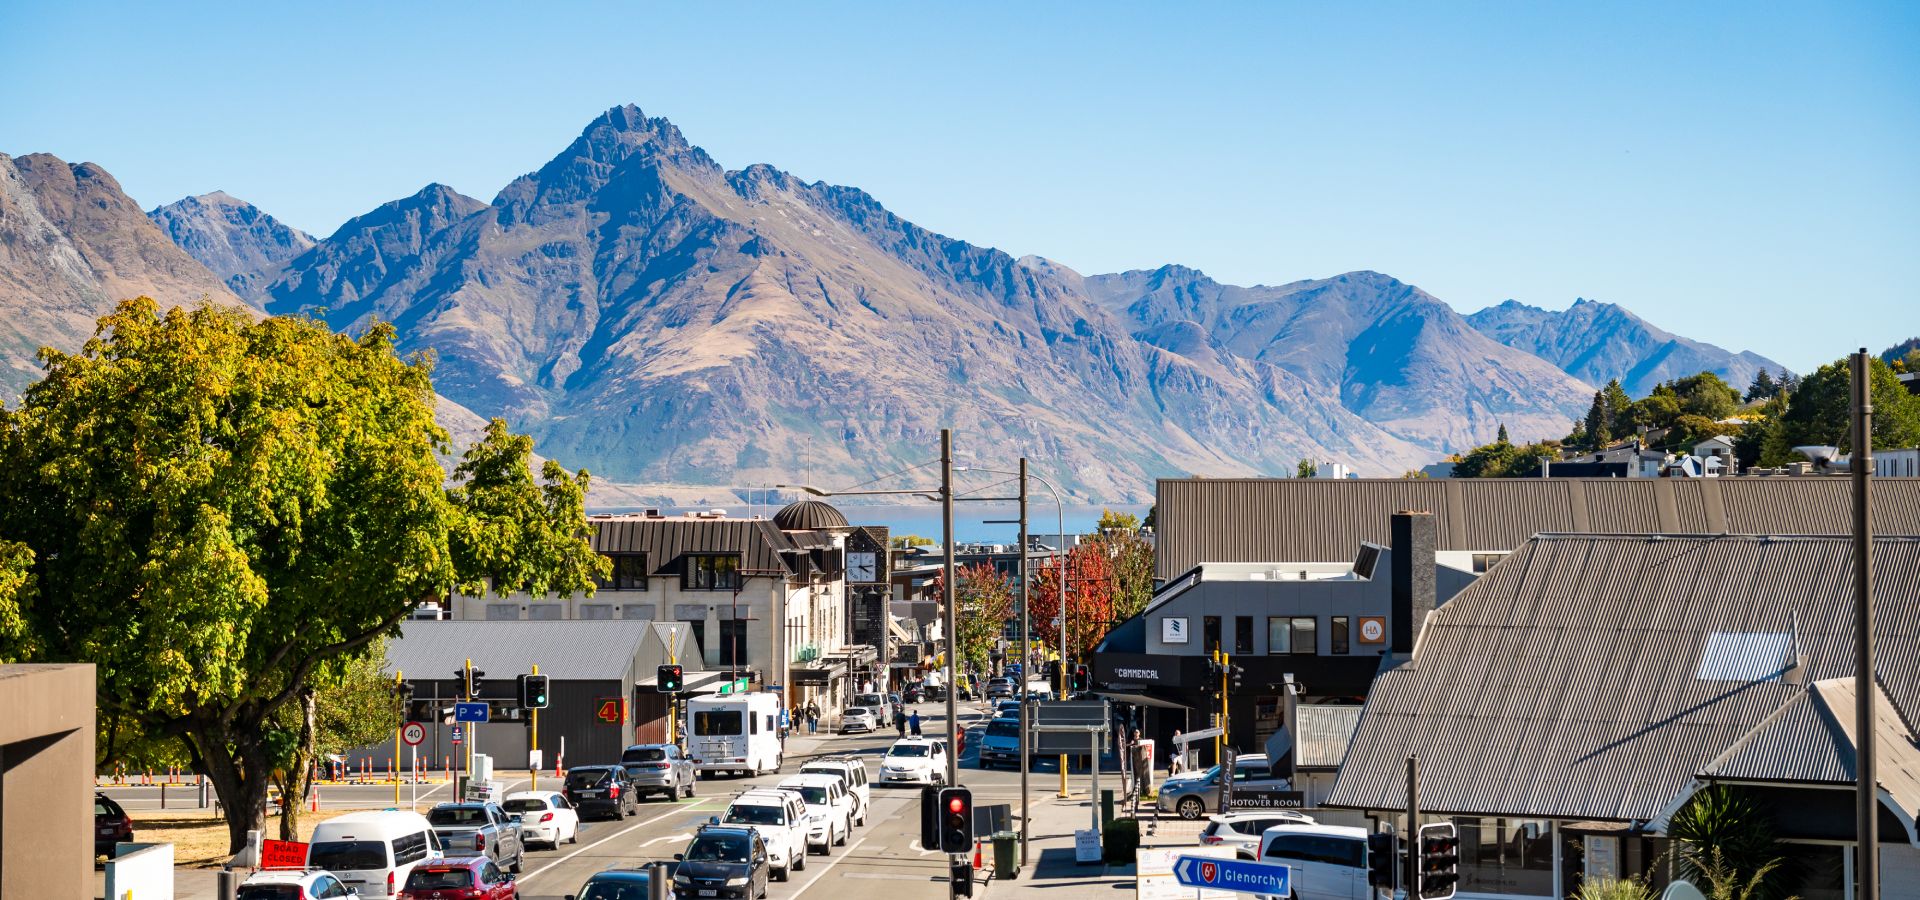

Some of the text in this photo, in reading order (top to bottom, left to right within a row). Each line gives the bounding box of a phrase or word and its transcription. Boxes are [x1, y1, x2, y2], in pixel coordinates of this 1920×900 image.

[1118, 668, 1159, 679] COMMENCAL
[459, 707, 468, 717] P
[598, 701, 619, 722] 4
[407, 729, 421, 739] 40
[1230, 799, 1301, 807] HOTOVER ROOM
[273, 844, 299, 853] ROAD
[267, 853, 303, 864] CLOSED
[1225, 869, 1284, 889] Glenorchy
